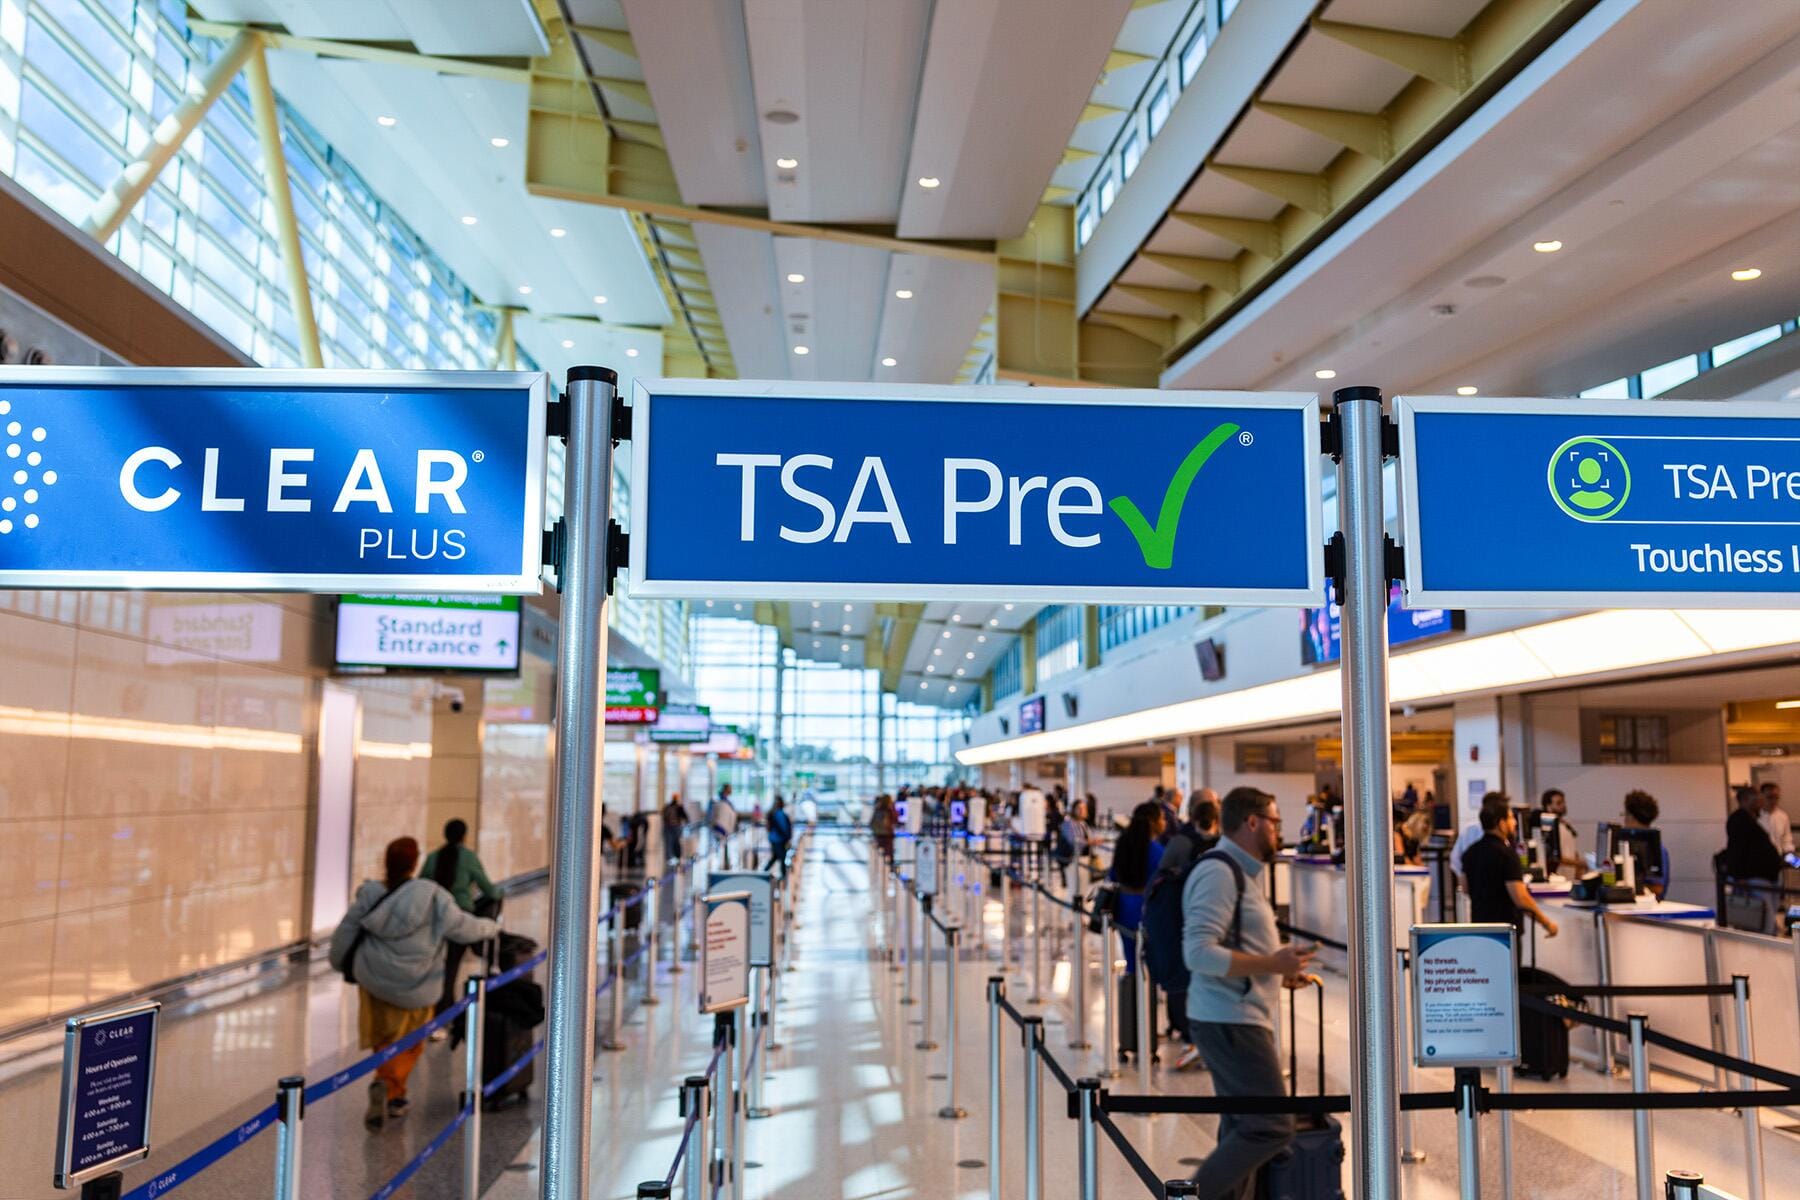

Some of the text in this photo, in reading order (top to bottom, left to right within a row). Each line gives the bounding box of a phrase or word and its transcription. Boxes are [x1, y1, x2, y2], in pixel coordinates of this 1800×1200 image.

[1663, 464, 1738, 499] TSA
[716, 453, 911, 545] TSA
[360, 528, 466, 560] PLUS
[1631, 543, 1783, 573] Touchless
[377, 615, 482, 637] Standard
[377, 634, 481, 655] Entrance
[109, 1026, 134, 1039] CLEAR
[85, 1054, 138, 1075] Hours of Operation
[158, 1173, 176, 1190] CLEAR
